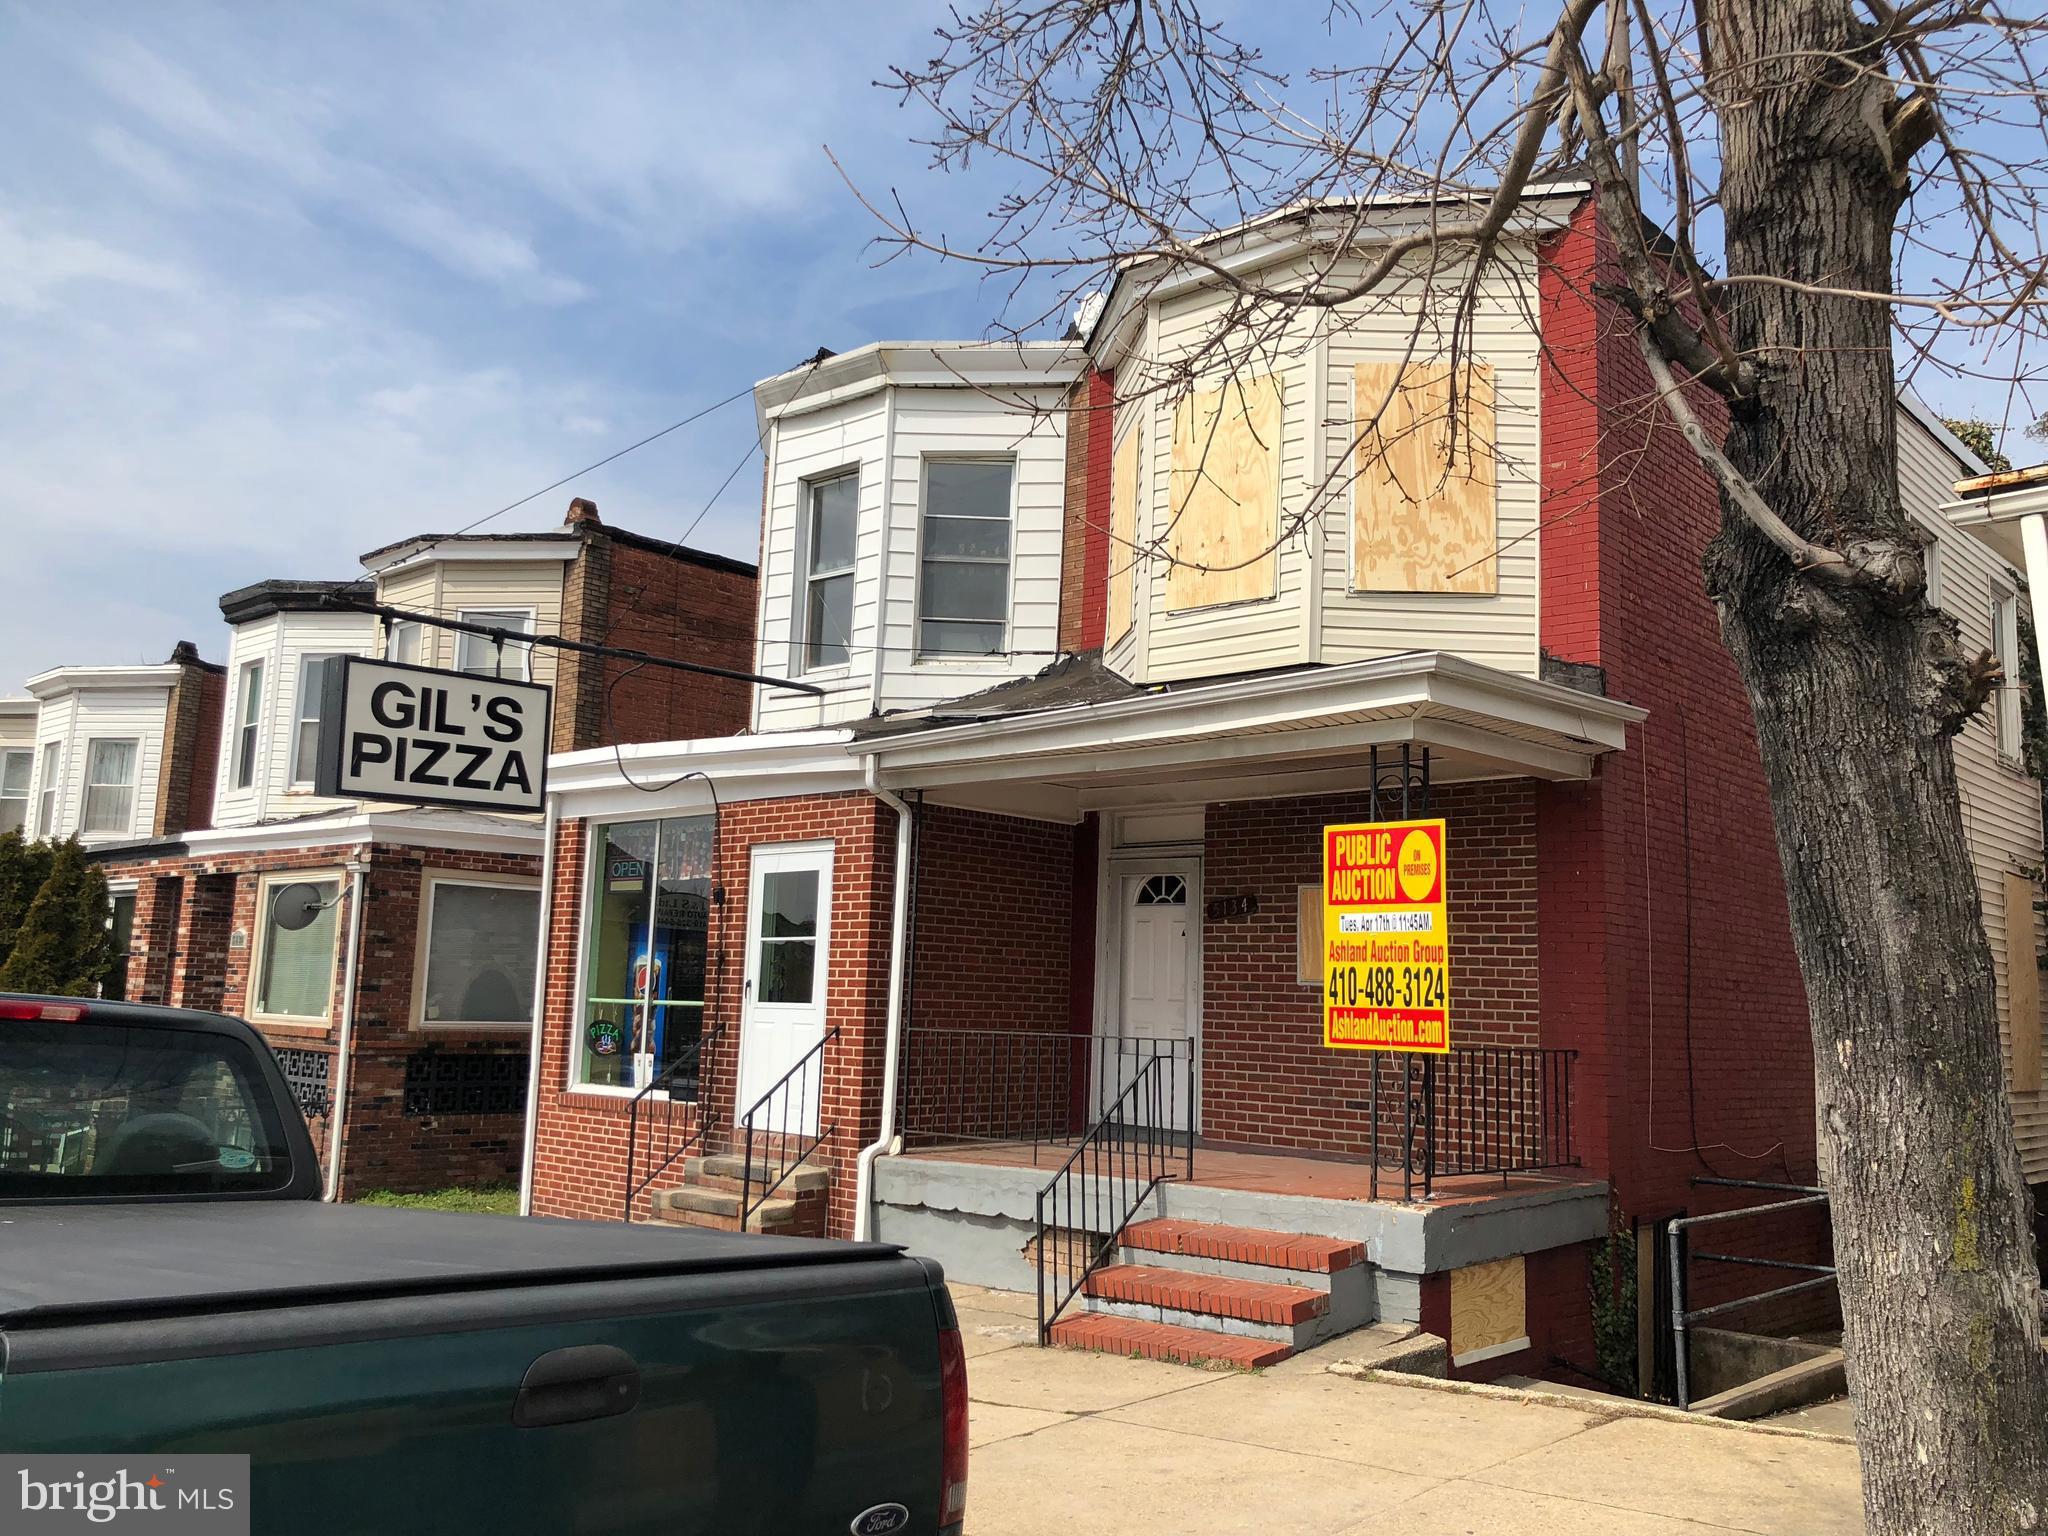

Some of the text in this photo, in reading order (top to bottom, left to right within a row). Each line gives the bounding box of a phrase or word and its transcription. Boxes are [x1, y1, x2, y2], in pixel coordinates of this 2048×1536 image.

[371, 681, 523, 743] GIL'S
[350, 731, 532, 794] PIZZA
[1335, 832, 1391, 866] PUBLIC
[1413, 849, 1421, 861] ON
[612, 861, 645, 877] OPEN
[1403, 863, 1431, 876] PREMISES
[1332, 867, 1396, 901] AUCTION
[1360, 915, 1373, 931] Apr
[1375, 914, 1391, 931] 17th
[1328, 939, 1444, 965] Ashland Auction Group
[1329, 966, 1445, 1007] 410-488-3124
[590, 1023, 619, 1041] PIZZA
[1331, 1010, 1443, 1044] AshlandAuction.com
[867, 1511, 897, 1532] Ford
